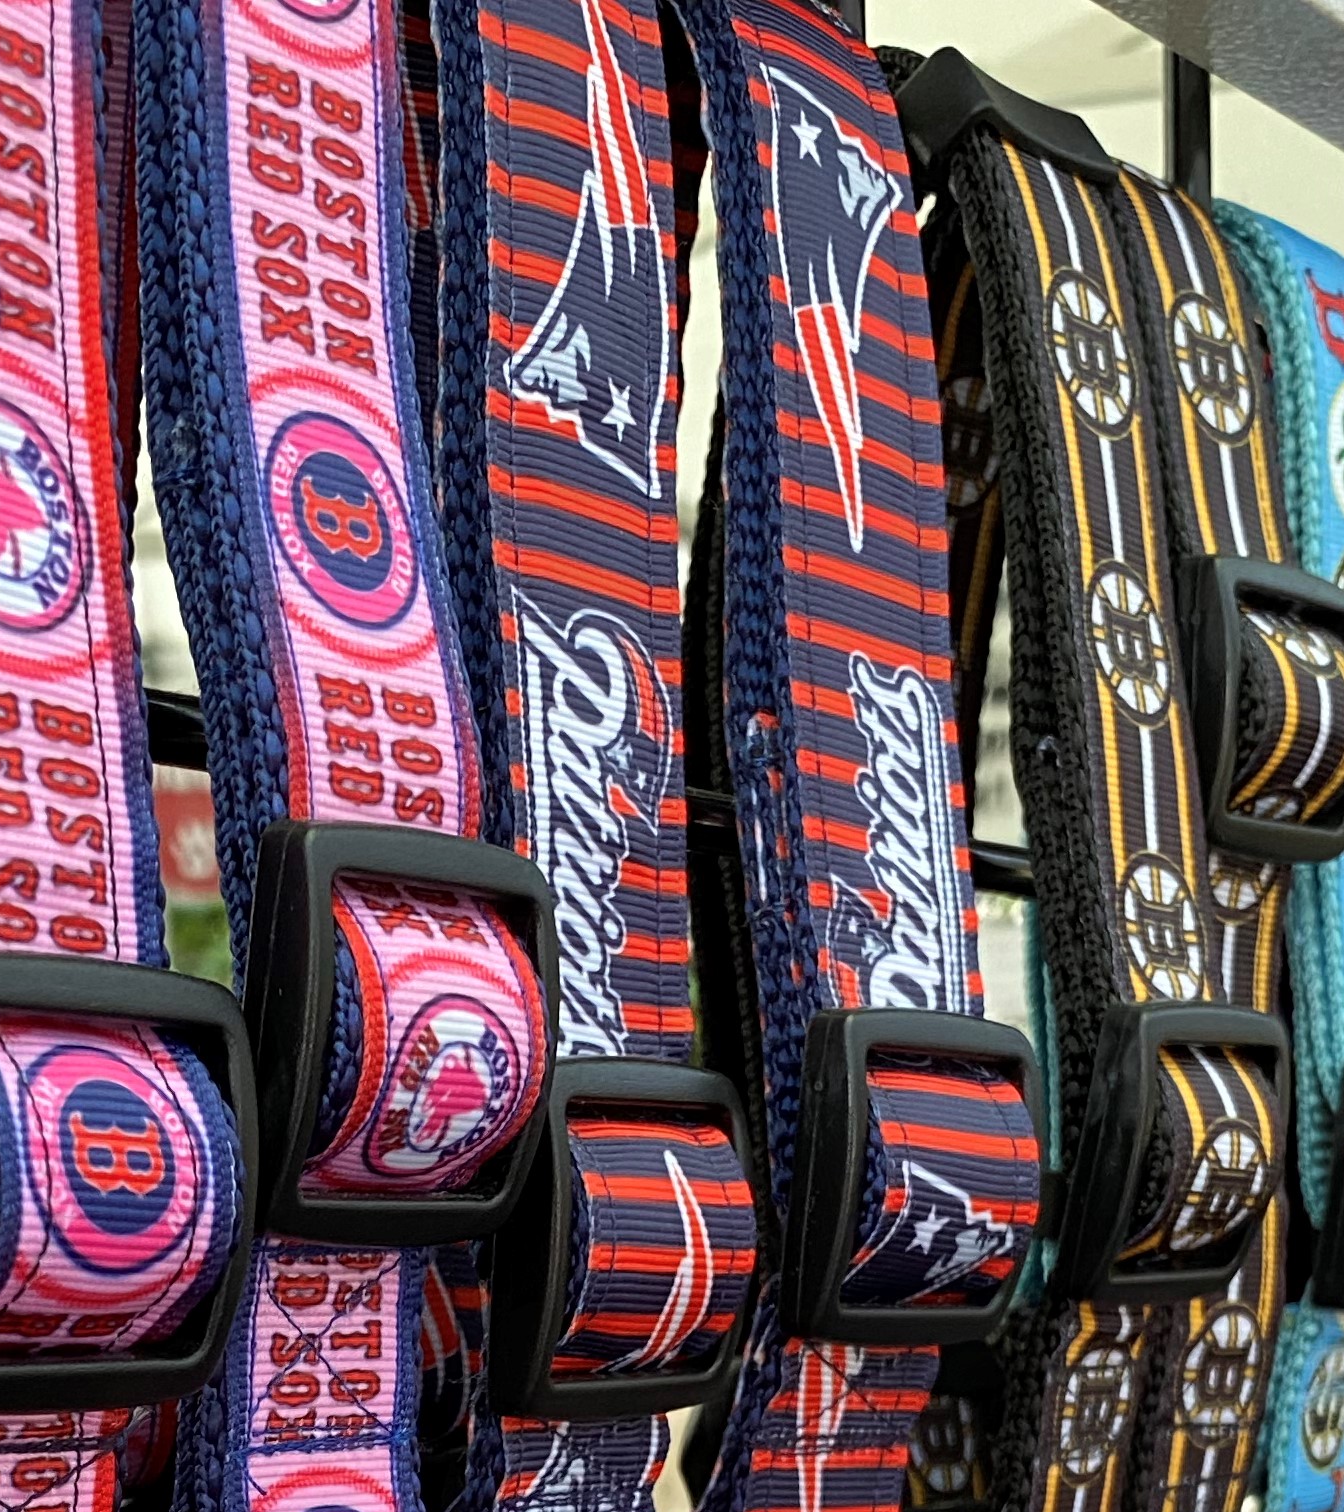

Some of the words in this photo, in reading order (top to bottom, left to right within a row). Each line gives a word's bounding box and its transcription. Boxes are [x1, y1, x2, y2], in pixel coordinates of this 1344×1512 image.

[245, 53, 304, 195] RED
[250, 209, 317, 357] SOX
[311, 79, 378, 376] BOSTON
[16, 436, 73, 610] BOSTON
[269, 438, 301, 500] RED
[299, 473, 385, 563] B
[370, 466, 416, 597] BOSTON
[275, 510, 321, 577] SOX
[314, 672, 385, 807] RED
[381, 688, 445, 826] BOS
[30, 698, 108, 954] BOSTO
[67, 1109, 167, 1198] B
[265, 1331, 324, 1444] SOX
